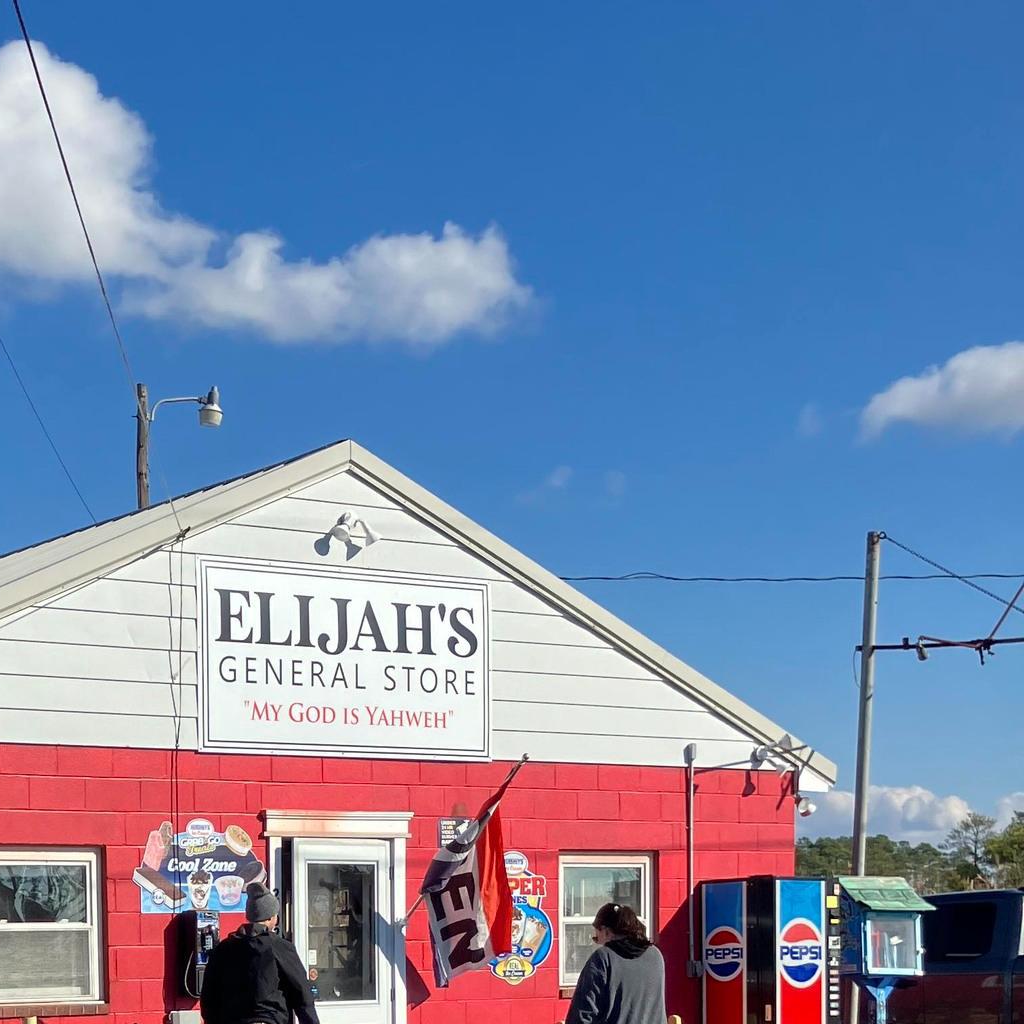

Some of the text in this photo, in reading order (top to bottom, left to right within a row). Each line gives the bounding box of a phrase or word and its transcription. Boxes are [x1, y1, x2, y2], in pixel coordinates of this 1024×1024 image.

[214, 588, 478, 658] ELIJAH'S
[219, 655, 476, 696] GENERAL STORE
[167, 858, 237, 872] Cool Zone
[507, 877, 545, 896] PER
[705, 947, 743, 960] PEPSI
[780, 945, 822, 961] PEPSI
